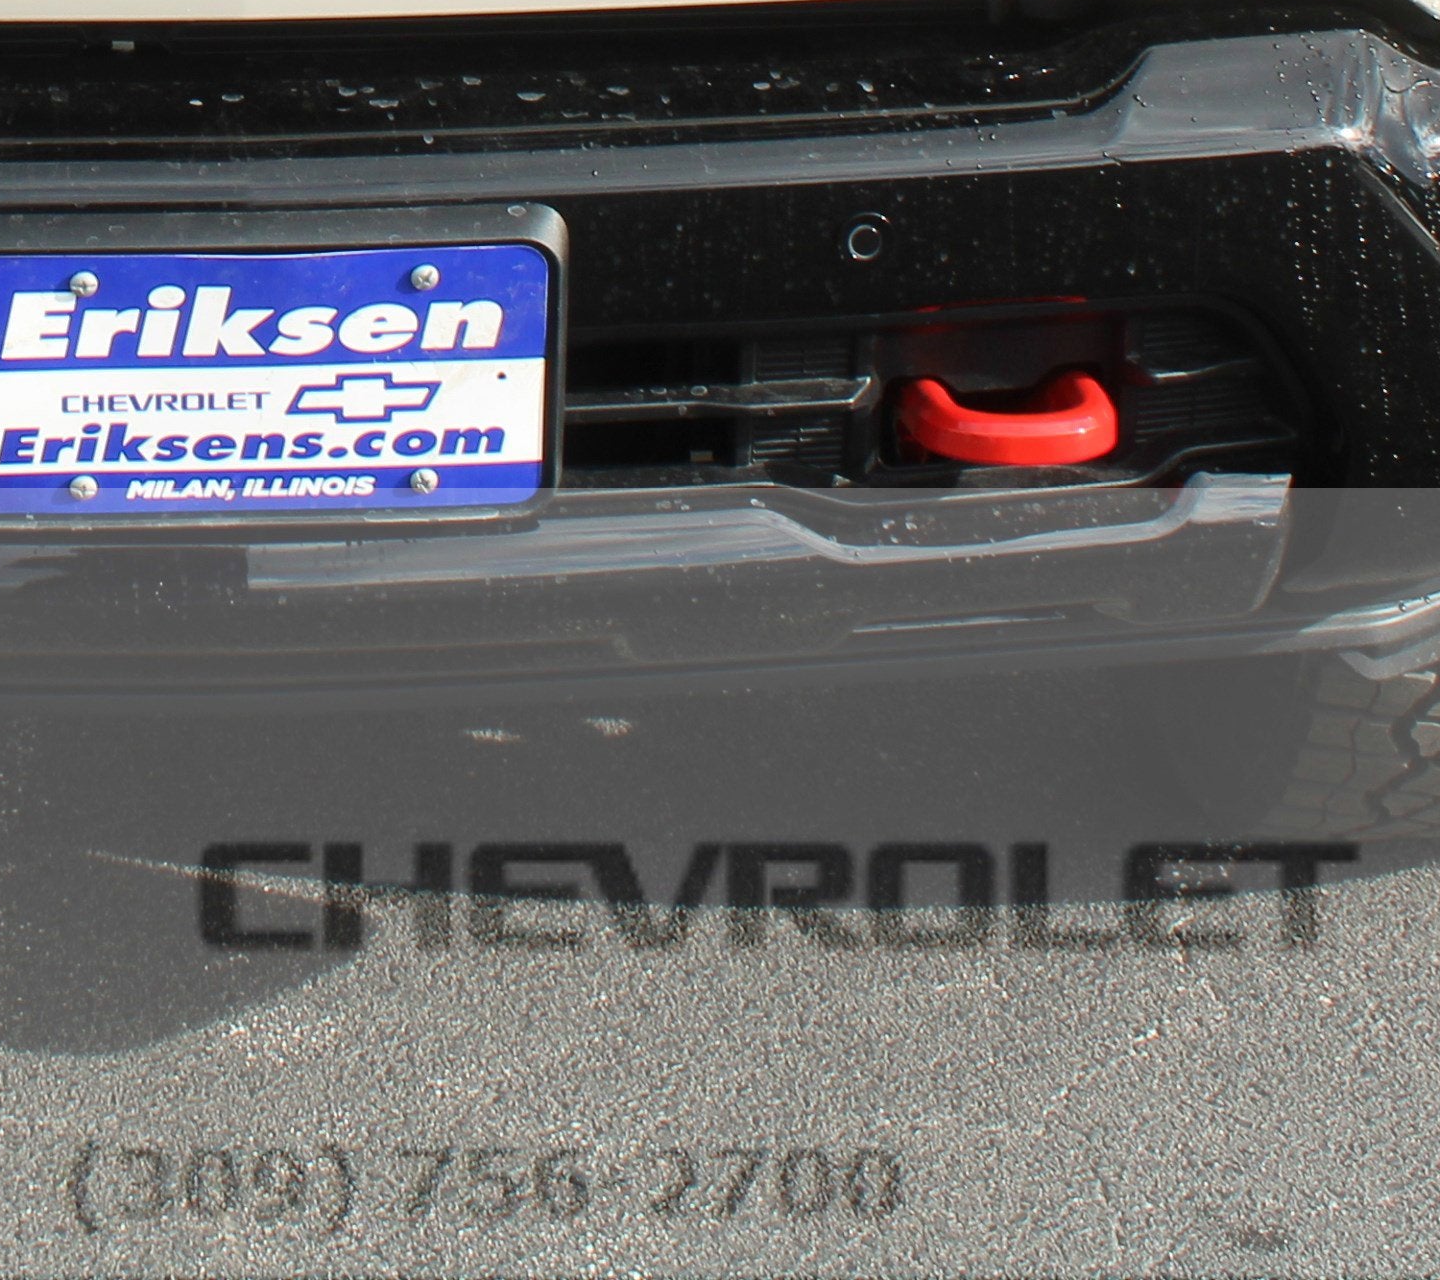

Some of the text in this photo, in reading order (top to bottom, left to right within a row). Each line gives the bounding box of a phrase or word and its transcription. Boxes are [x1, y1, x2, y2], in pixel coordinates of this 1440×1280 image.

[0, 285, 505, 361] Eriksen
[60, 390, 271, 415] CHEVROLET
[126, 475, 376, 502] MILAN, ILLINOIS
